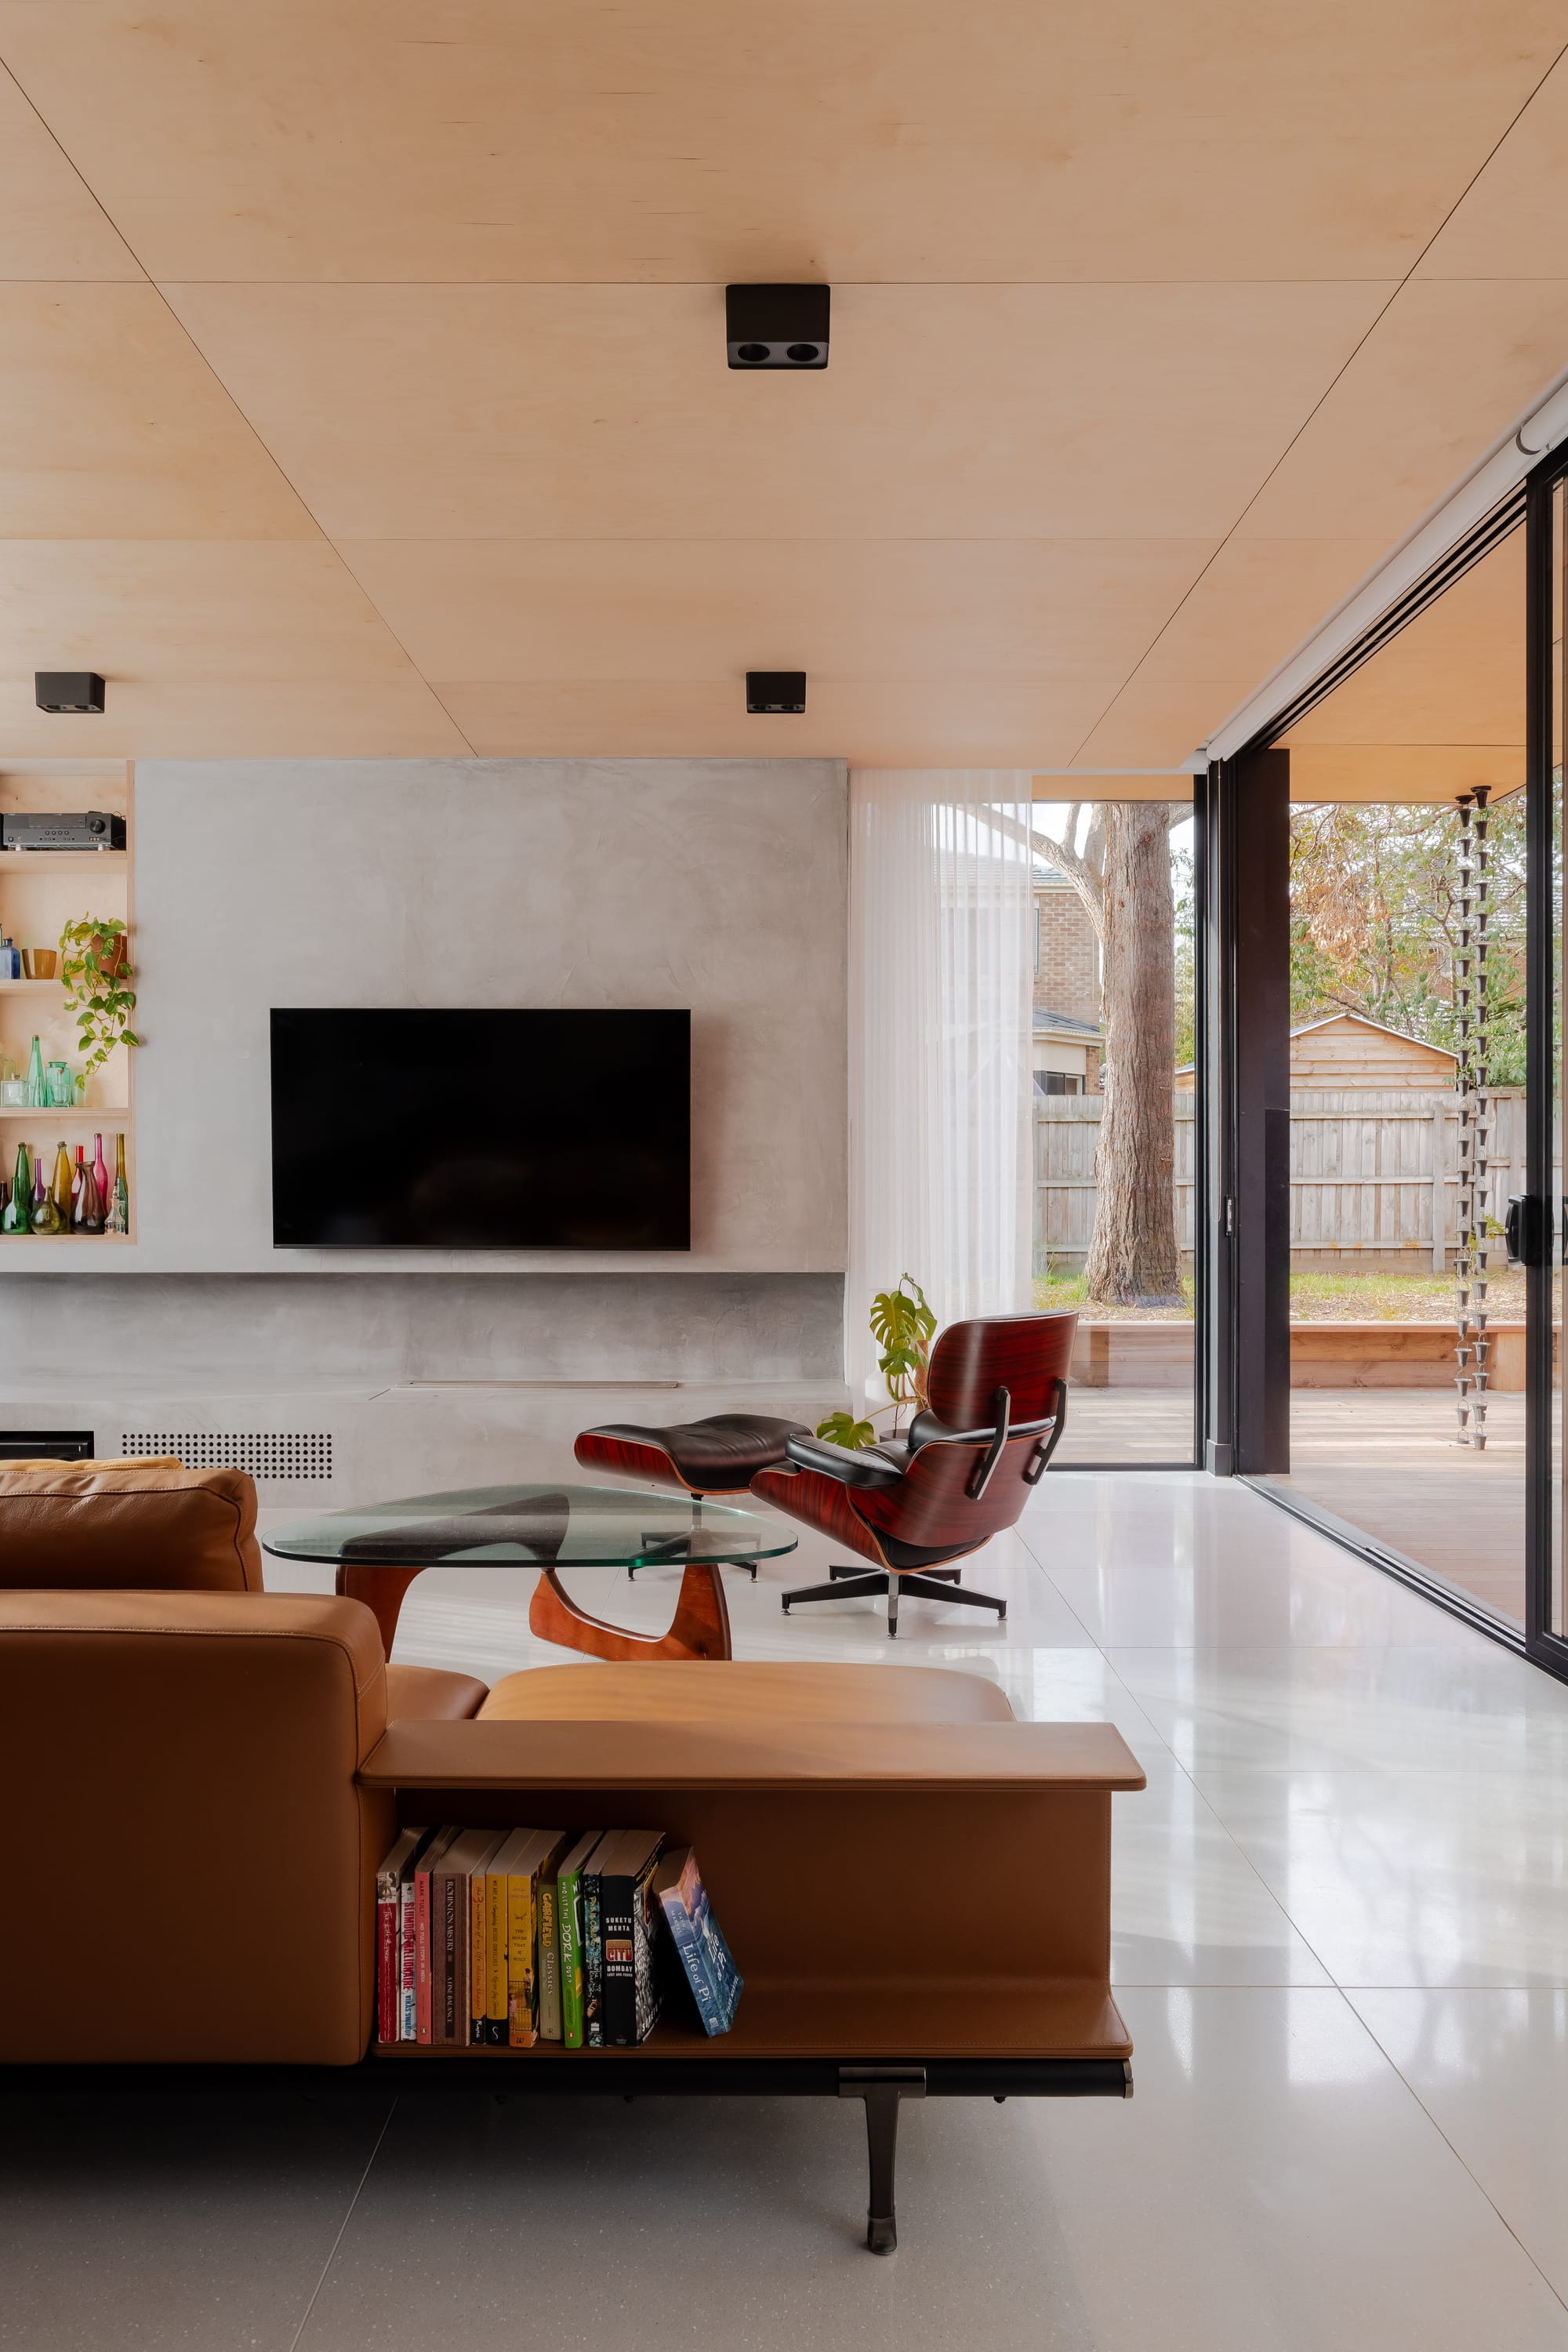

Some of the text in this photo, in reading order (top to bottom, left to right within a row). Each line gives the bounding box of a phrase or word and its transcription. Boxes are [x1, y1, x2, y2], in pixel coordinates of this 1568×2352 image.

[447, 1881, 456, 1922] ROHINTON
[541, 1893, 553, 1948] GARFIELD
[562, 1922, 572, 1963] DORK
[682, 1942, 712, 2003] Life of Pi
